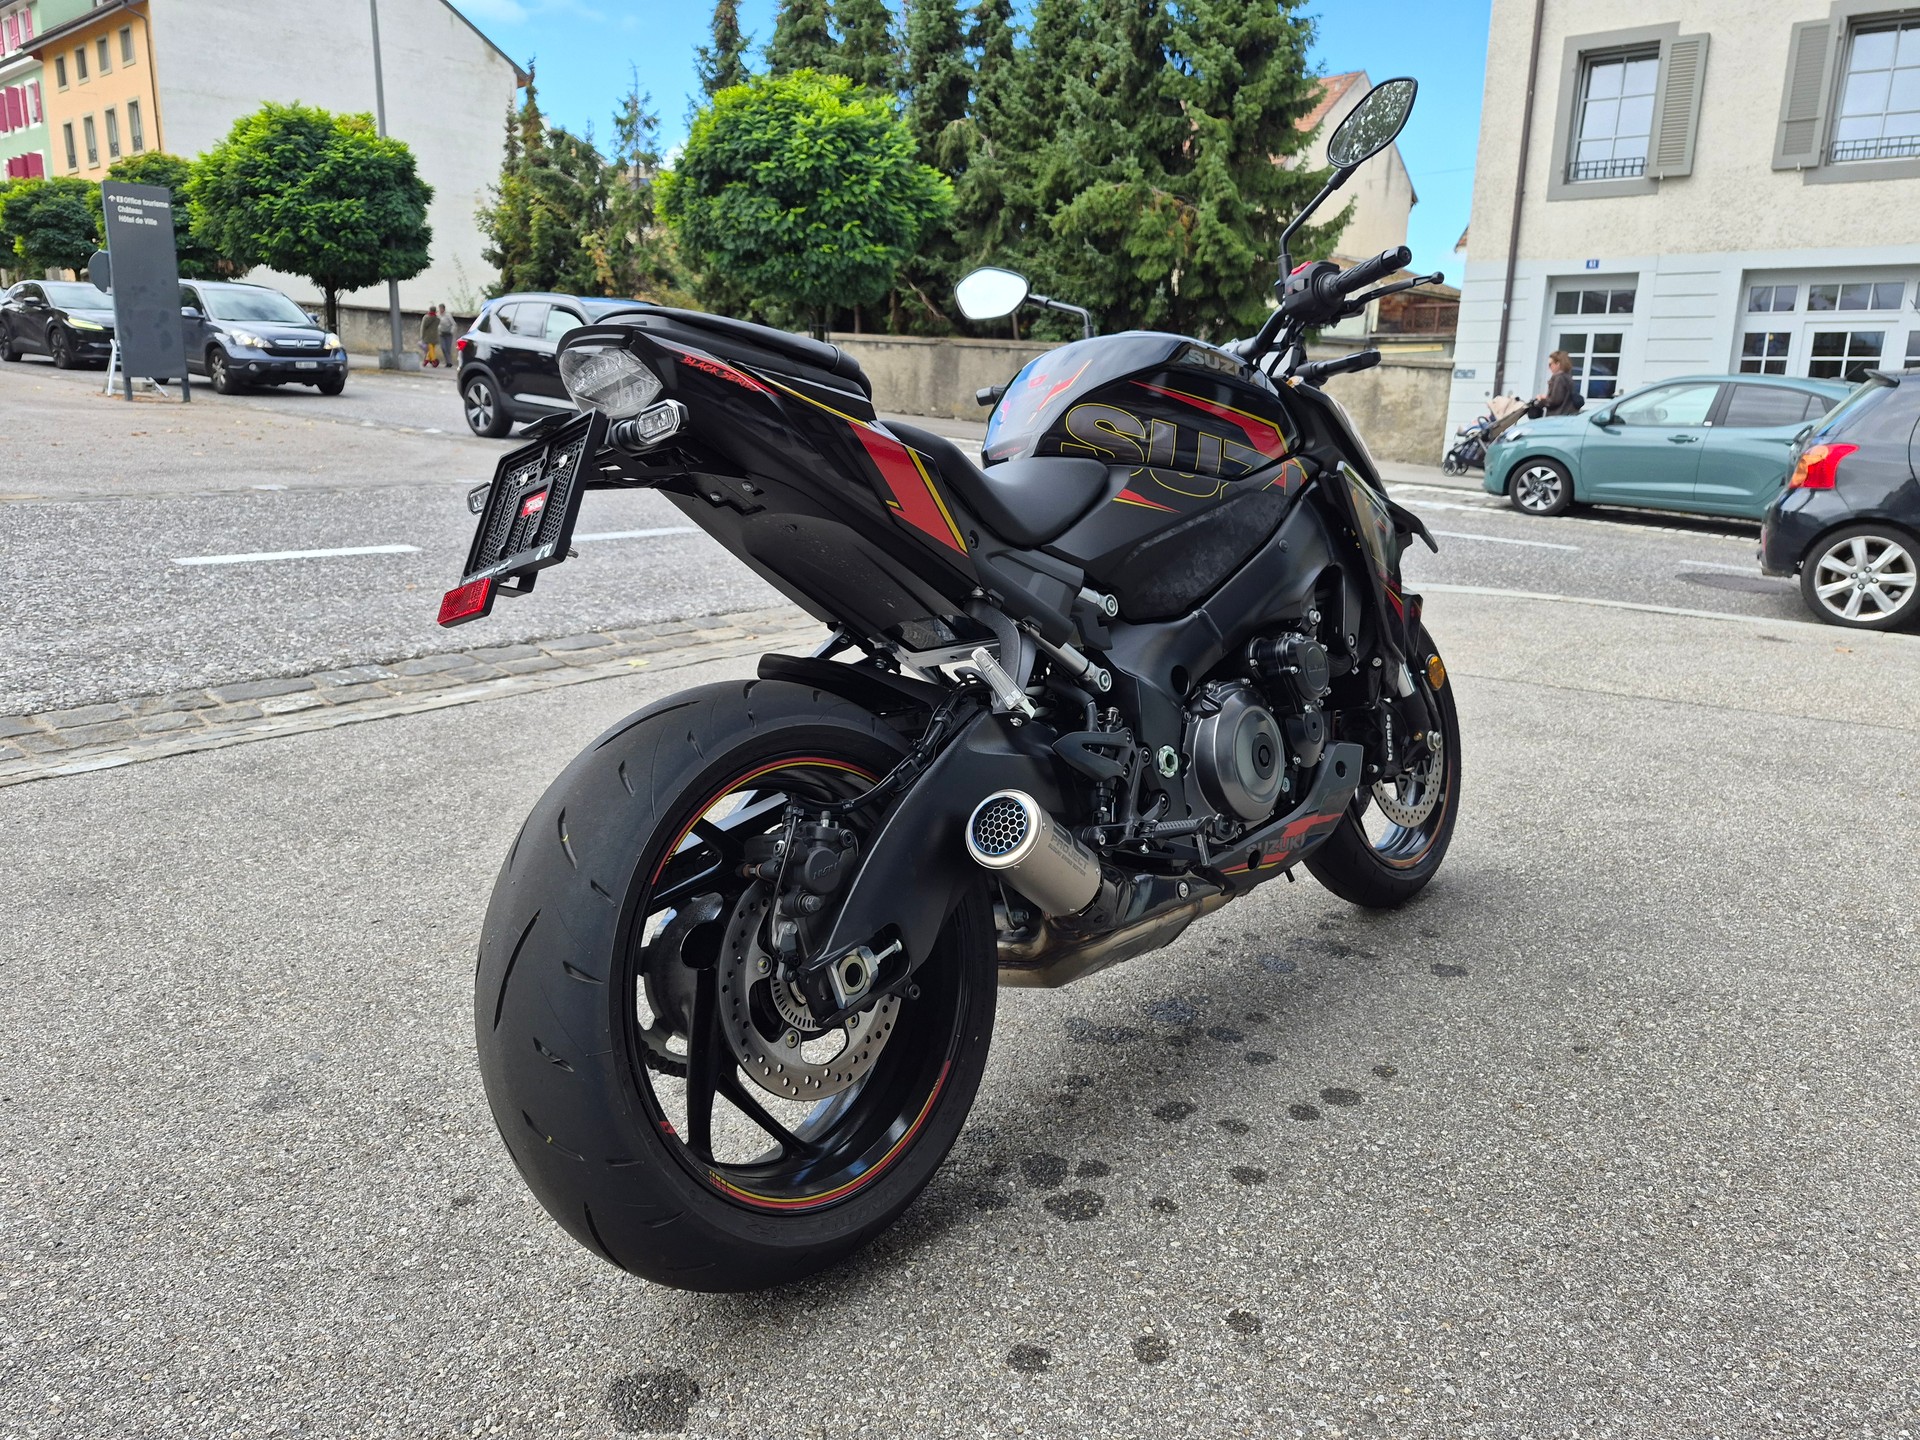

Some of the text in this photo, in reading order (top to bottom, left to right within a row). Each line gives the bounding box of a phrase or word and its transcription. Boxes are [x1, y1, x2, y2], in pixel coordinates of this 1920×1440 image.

[117, 205, 143, 215] Château
[124, 196, 169, 208] Office tourisme
[118, 215, 135, 223] Hôtel
[144, 218, 158, 226] Ville
[681, 355, 719, 375] BLACK
[1188, 349, 1253, 381] SUZU
[1060, 402, 1302, 501] SUZ
[1385, 714, 1393, 761] brembo
[1050, 833, 1088, 870] PROJECT
